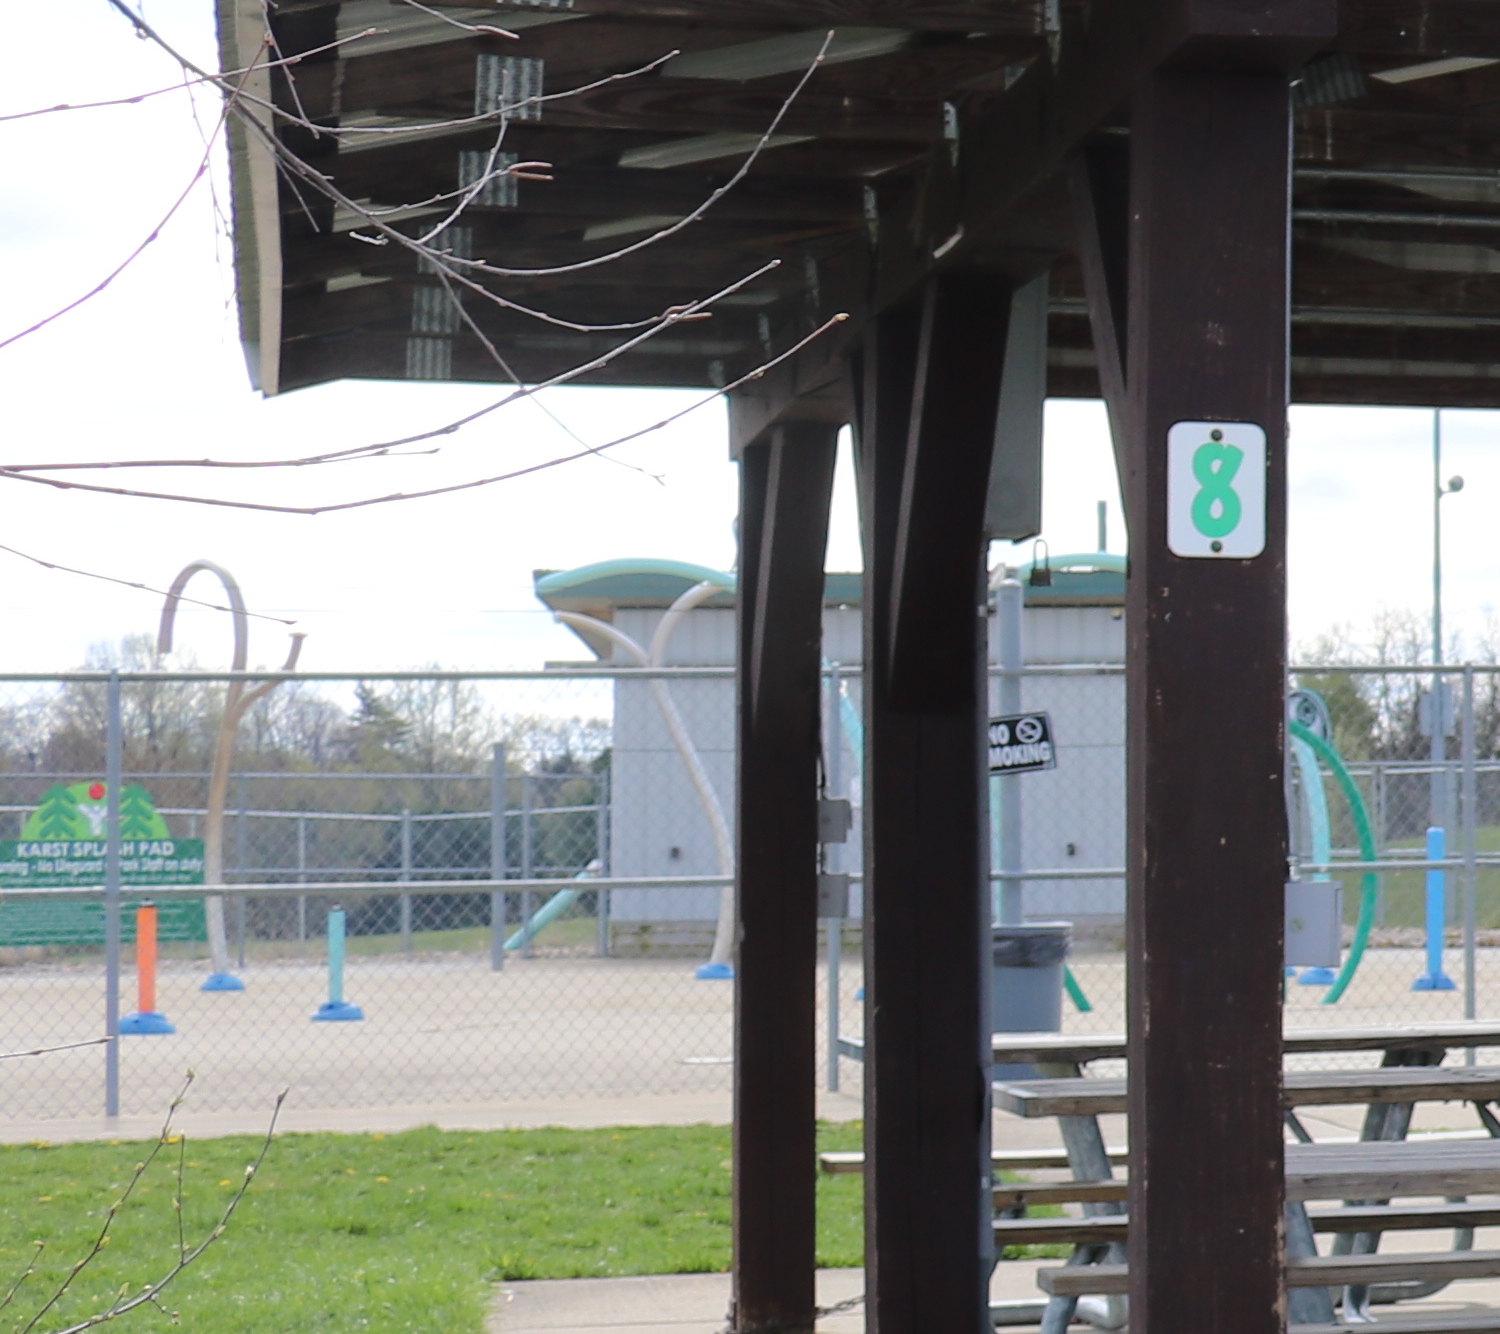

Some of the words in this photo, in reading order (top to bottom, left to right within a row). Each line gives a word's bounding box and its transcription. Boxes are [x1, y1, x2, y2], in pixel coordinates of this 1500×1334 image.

[1191, 442, 1244, 538] 8
[988, 741, 1051, 767] MOKING
[17, 842, 69, 858] KARST
[73, 841, 135, 857] SPLAH
[139, 841, 175, 856] PAD
